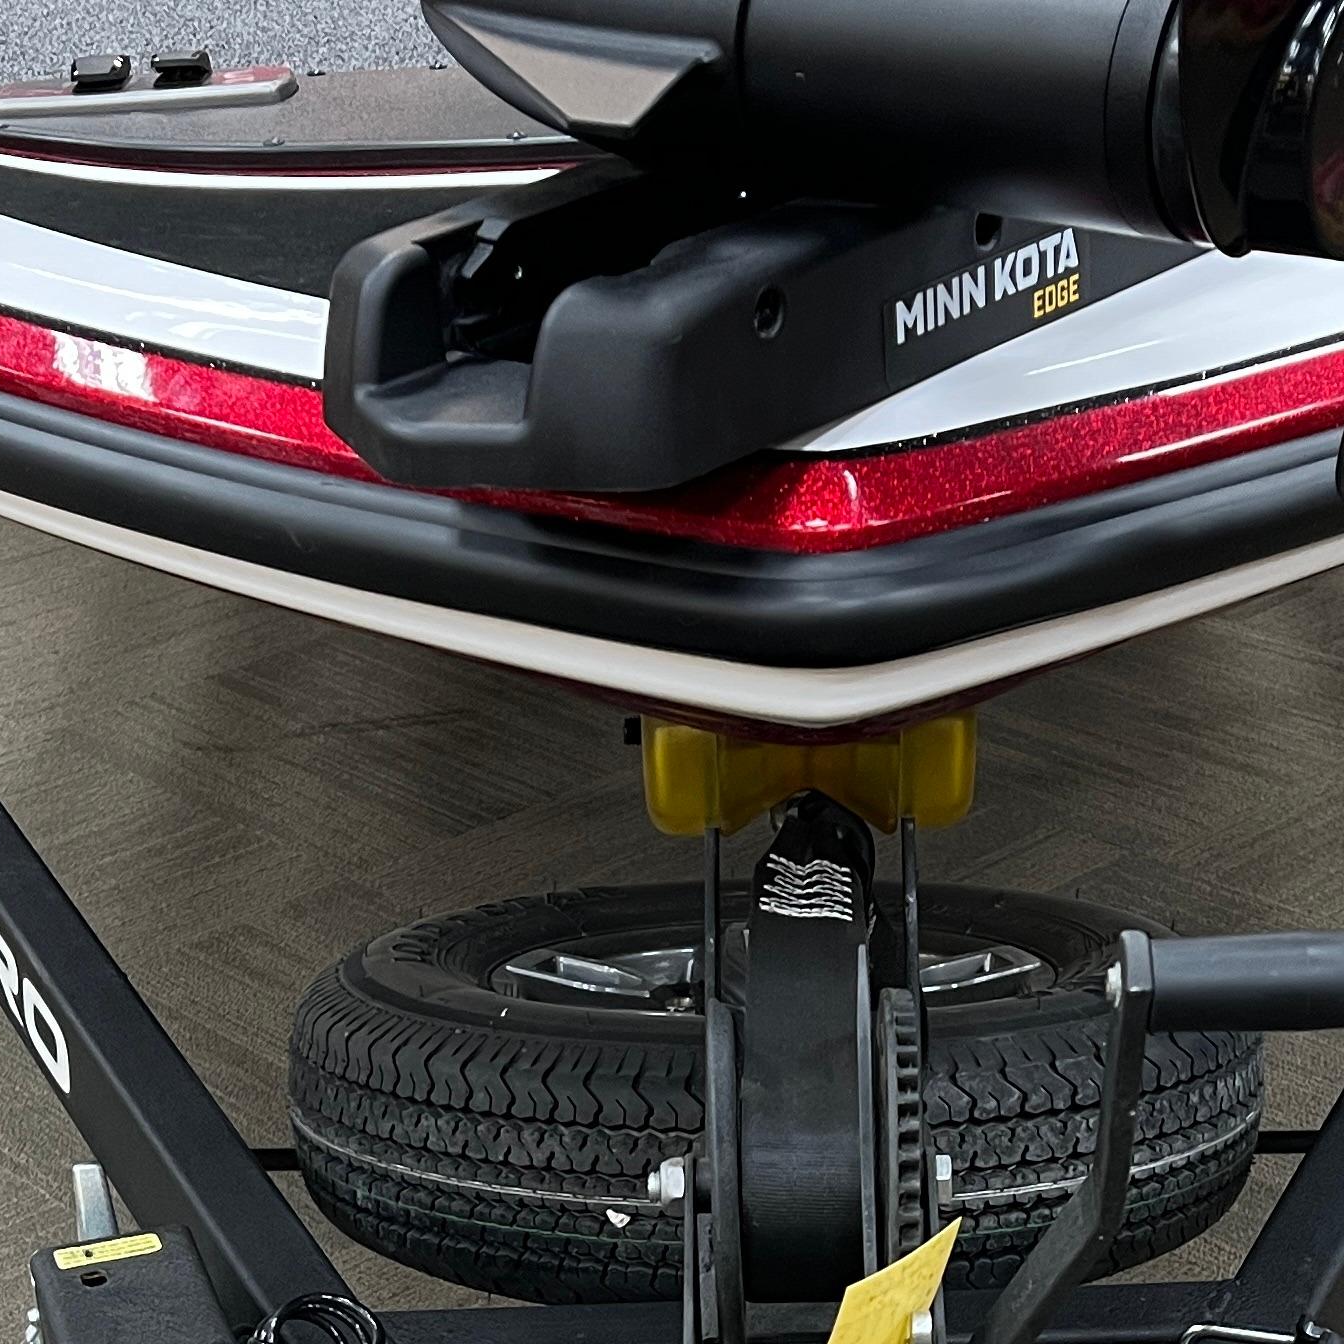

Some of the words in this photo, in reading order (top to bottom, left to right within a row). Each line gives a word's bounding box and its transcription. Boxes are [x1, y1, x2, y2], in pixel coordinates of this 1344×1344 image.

[895, 264, 986, 346] MINN
[994, 227, 1080, 301] KOTA
[1033, 273, 1080, 319] EDGE
